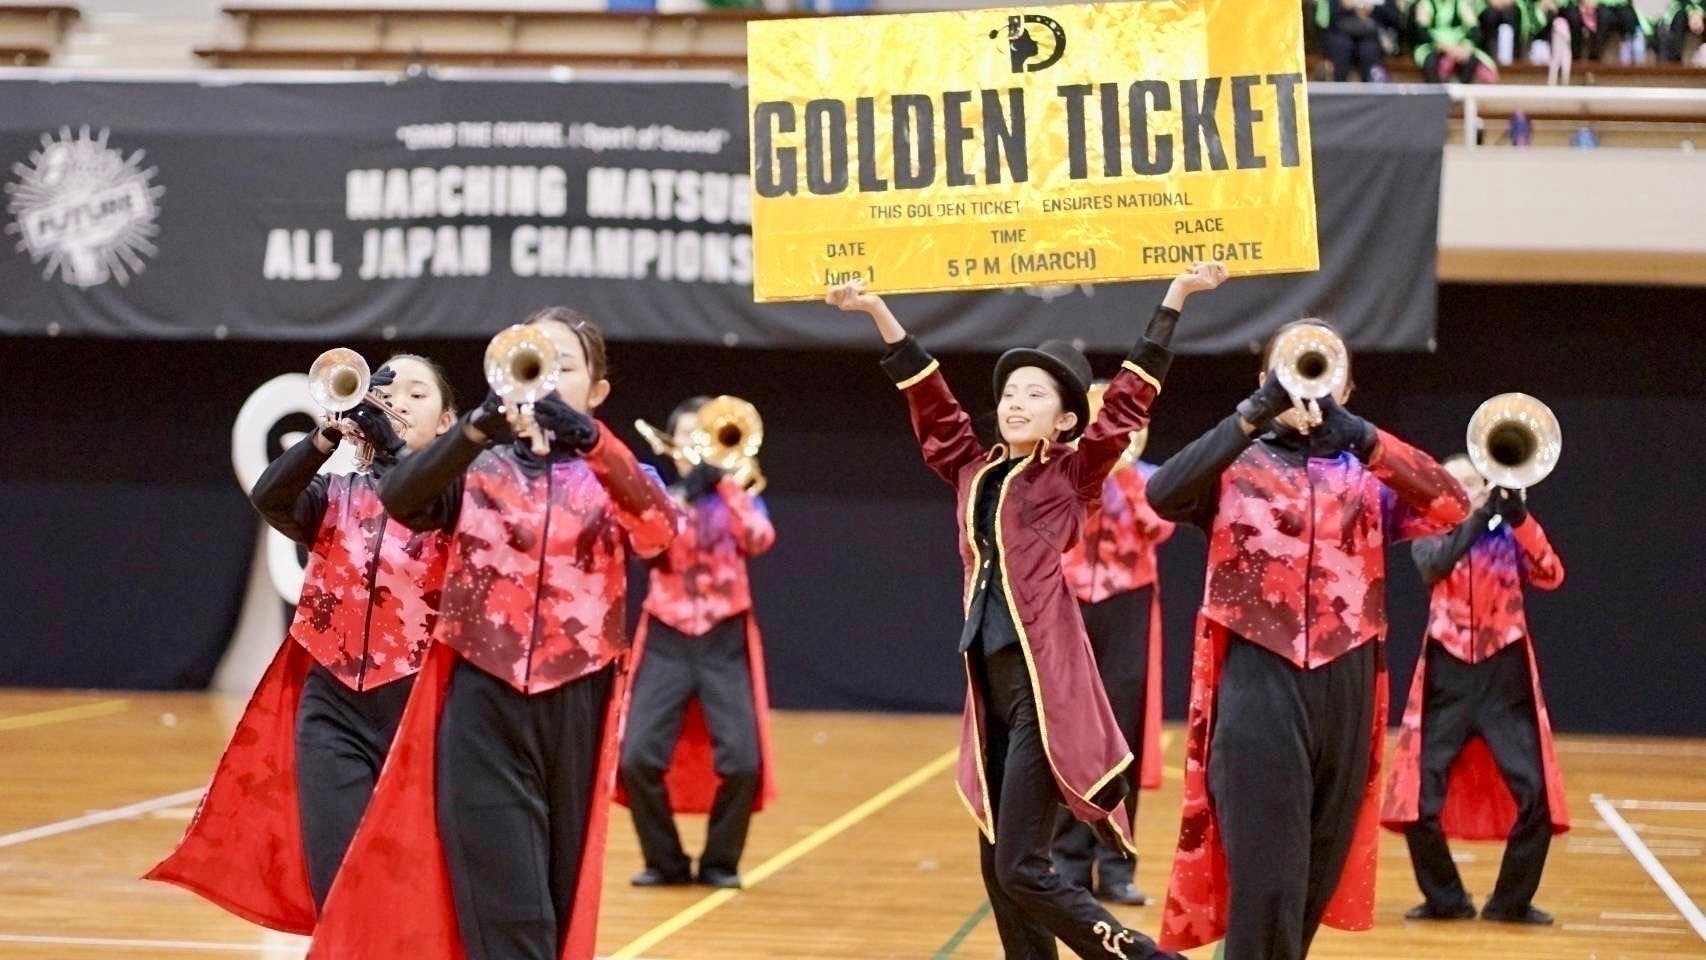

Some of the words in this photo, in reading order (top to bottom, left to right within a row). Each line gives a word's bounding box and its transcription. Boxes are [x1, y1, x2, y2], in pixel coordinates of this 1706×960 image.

[753, 87, 1028, 198] GOLDEN
[1057, 72, 1303, 180] TICKET
[345, 165, 568, 220] MARCHING
[870, 205, 902, 219] THIS
[907, 203, 966, 218] GOLDEN
[972, 200, 1021, 216] TICKET
[1043, 194, 1113, 213] ENSURES
[1117, 191, 1193, 208] NATIONAL
[991, 229, 1026, 244] TIME
[1175, 218, 1224, 234] PLACE
[263, 228, 342, 280] ALL
[359, 226, 492, 278] JAPAN
[826, 242, 865, 258] DATE
[947, 259, 960, 277] 5
[1010, 247, 1097, 275] (MARCH)
[1142, 243, 1206, 264] FRONT
[1212, 242, 1263, 262] GATE
[823, 269, 862, 286] June
[867, 265, 875, 282] 1
